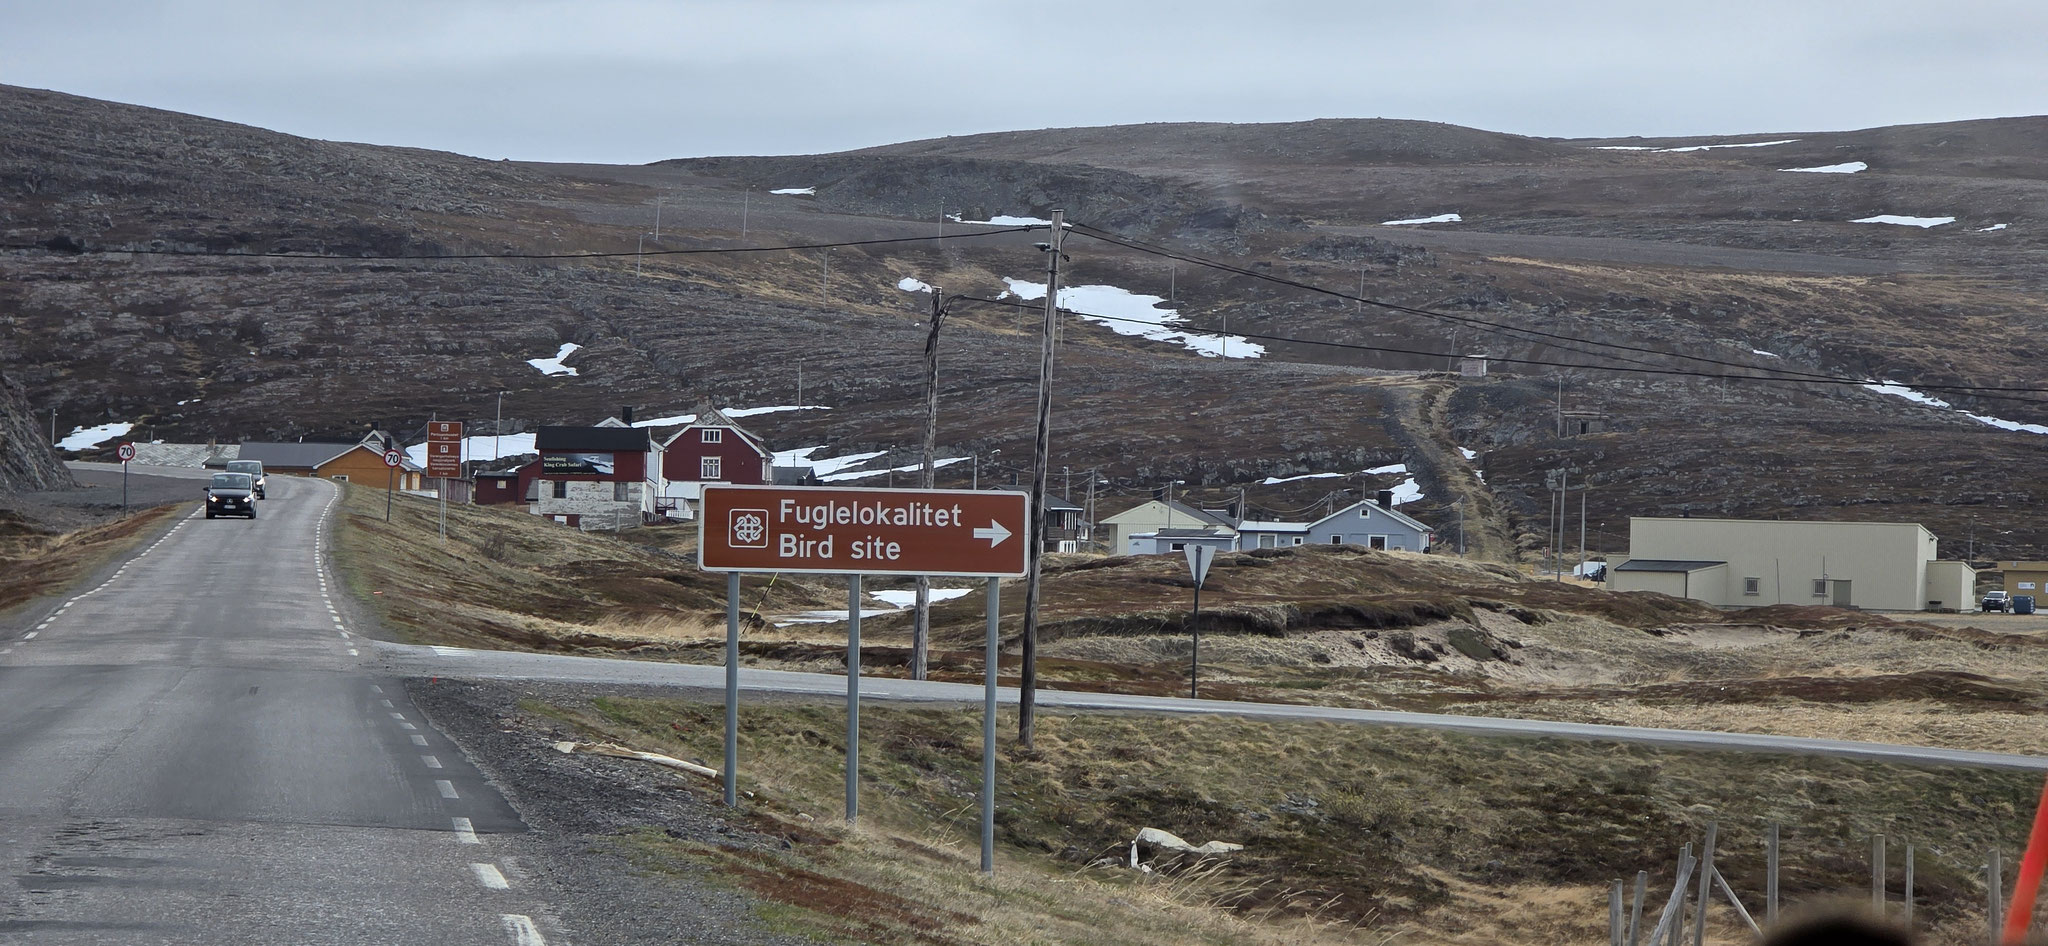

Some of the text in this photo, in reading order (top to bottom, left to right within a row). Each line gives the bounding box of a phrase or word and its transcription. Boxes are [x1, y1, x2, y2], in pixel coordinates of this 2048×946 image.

[121, 447, 133, 457] 70
[387, 454, 399, 464] 70
[779, 498, 962, 530] Fuglelokalitet
[779, 533, 901, 560] Bird site
